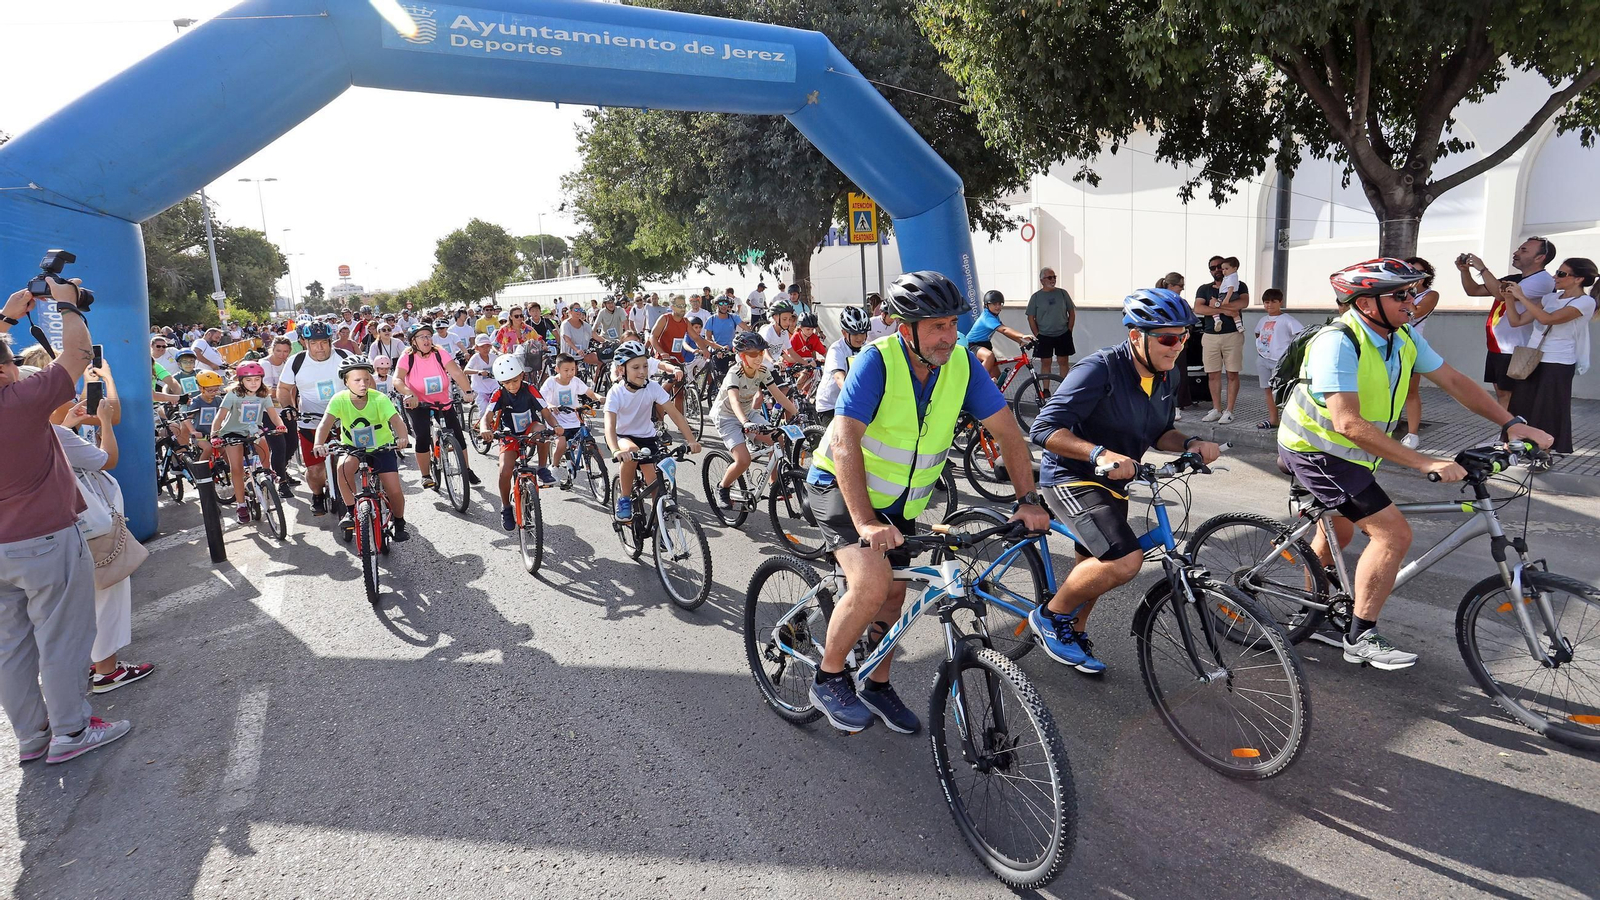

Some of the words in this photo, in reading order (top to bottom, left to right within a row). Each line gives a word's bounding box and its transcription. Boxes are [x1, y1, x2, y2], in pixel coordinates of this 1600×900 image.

[449, 14, 676, 52] Ayuntamiento
[683, 40, 715, 56] de
[722, 43, 786, 62] Jerez
[450, 34, 563, 57] Deportes
[853, 233, 875, 241] PEATONES
